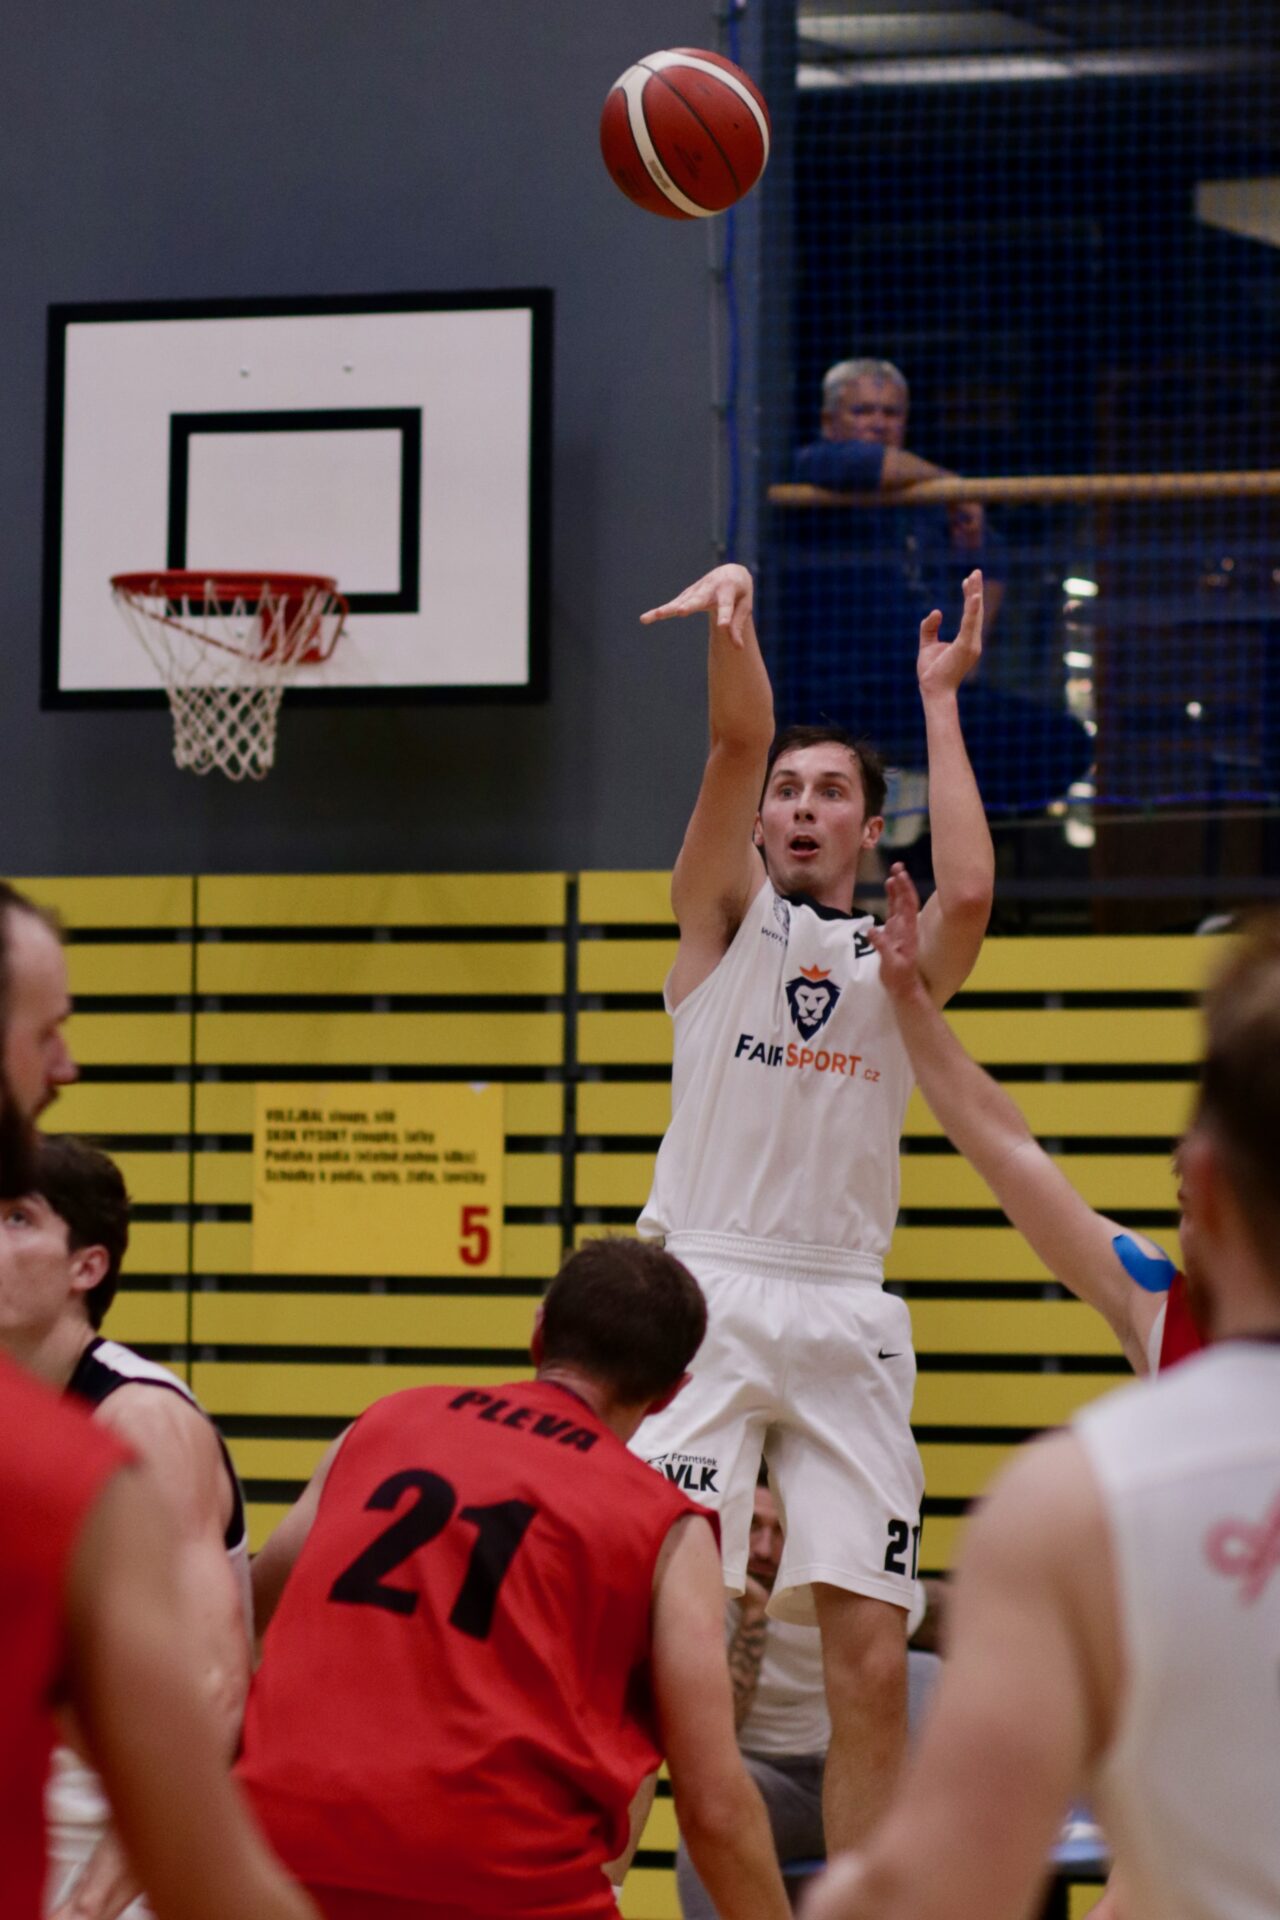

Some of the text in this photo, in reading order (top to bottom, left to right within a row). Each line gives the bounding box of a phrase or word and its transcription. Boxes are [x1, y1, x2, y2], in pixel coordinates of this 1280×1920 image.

[265, 1108, 323, 1123] VOLEJBAL
[460, 1204, 491, 1267] 5
[447, 1389, 600, 1453] PLEVA
[665, 1463, 720, 1493] VLK
[328, 1467, 539, 1643] 21
